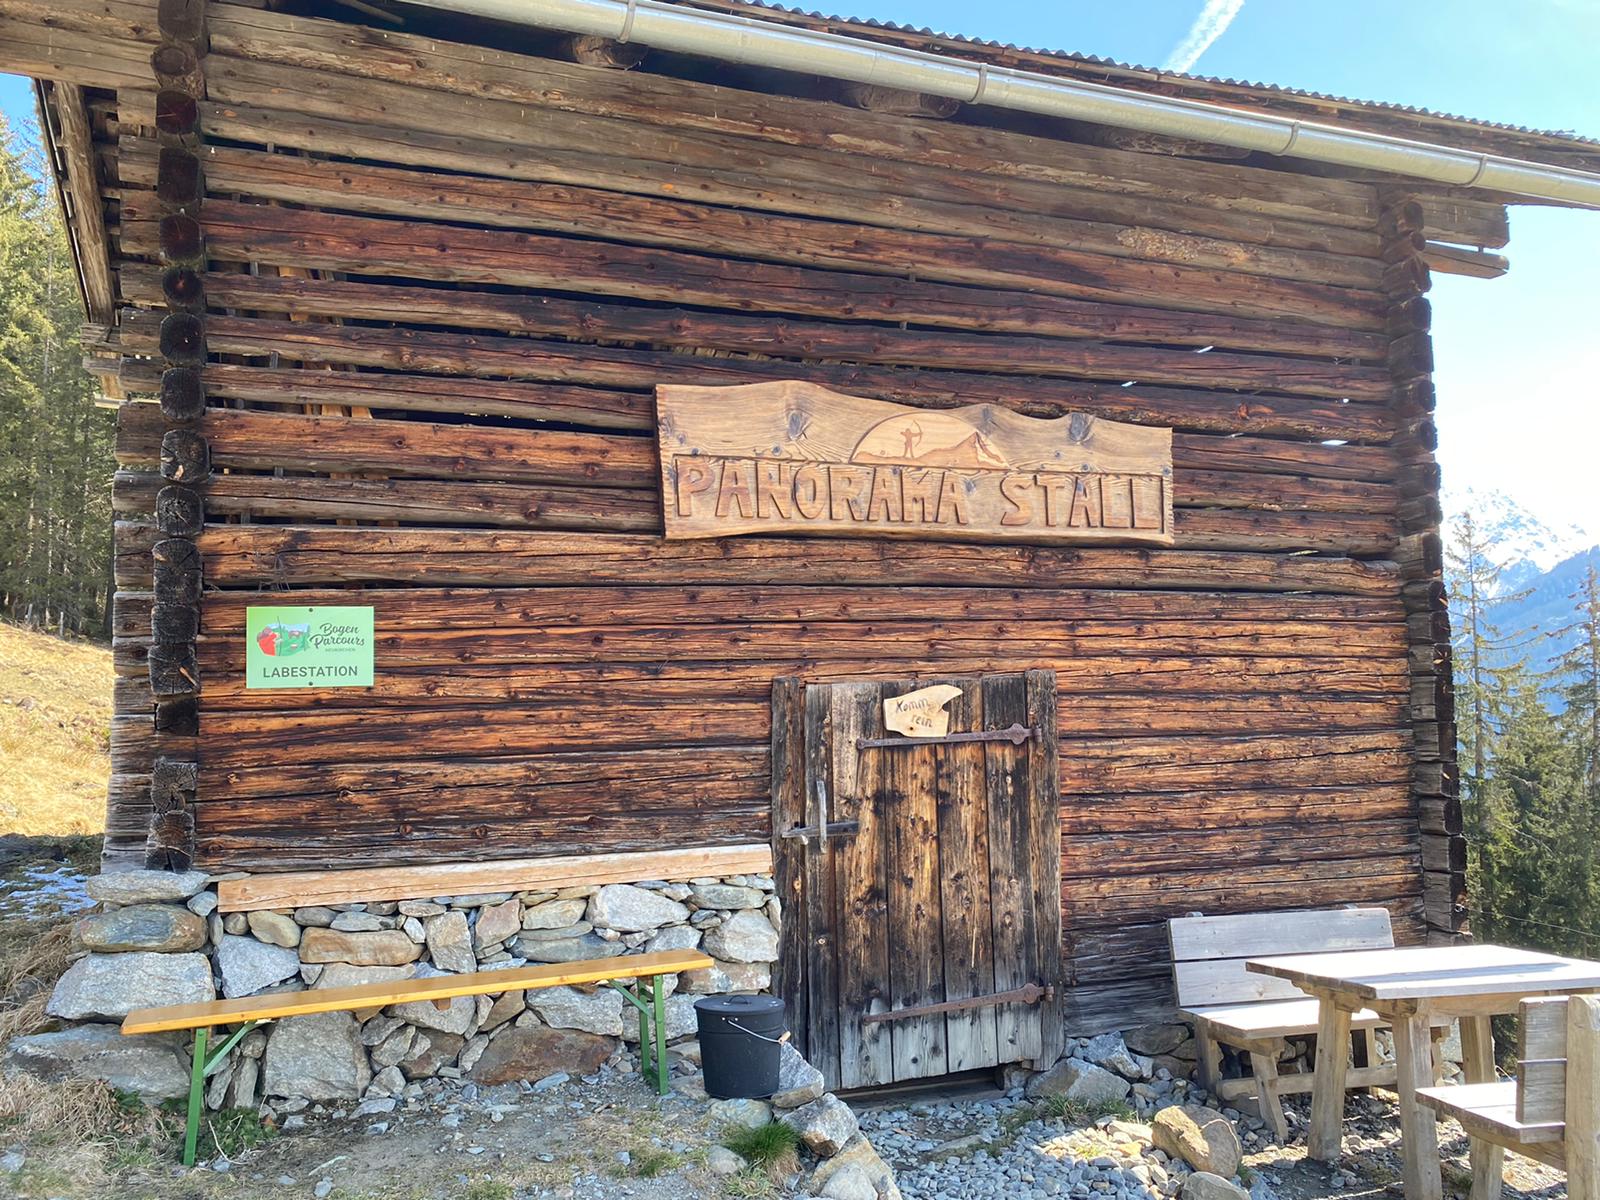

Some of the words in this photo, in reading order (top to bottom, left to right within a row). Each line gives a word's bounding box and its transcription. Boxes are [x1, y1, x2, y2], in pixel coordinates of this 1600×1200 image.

[675, 456, 968, 525] PANORAMA
[1000, 472, 1164, 530] STALL
[319, 622, 360, 637] Bogen
[309, 633, 365, 649] Parcours
[263, 665, 358, 678] LABESTATION
[895, 698, 929, 713] Komm
[911, 714, 933, 728] rein
